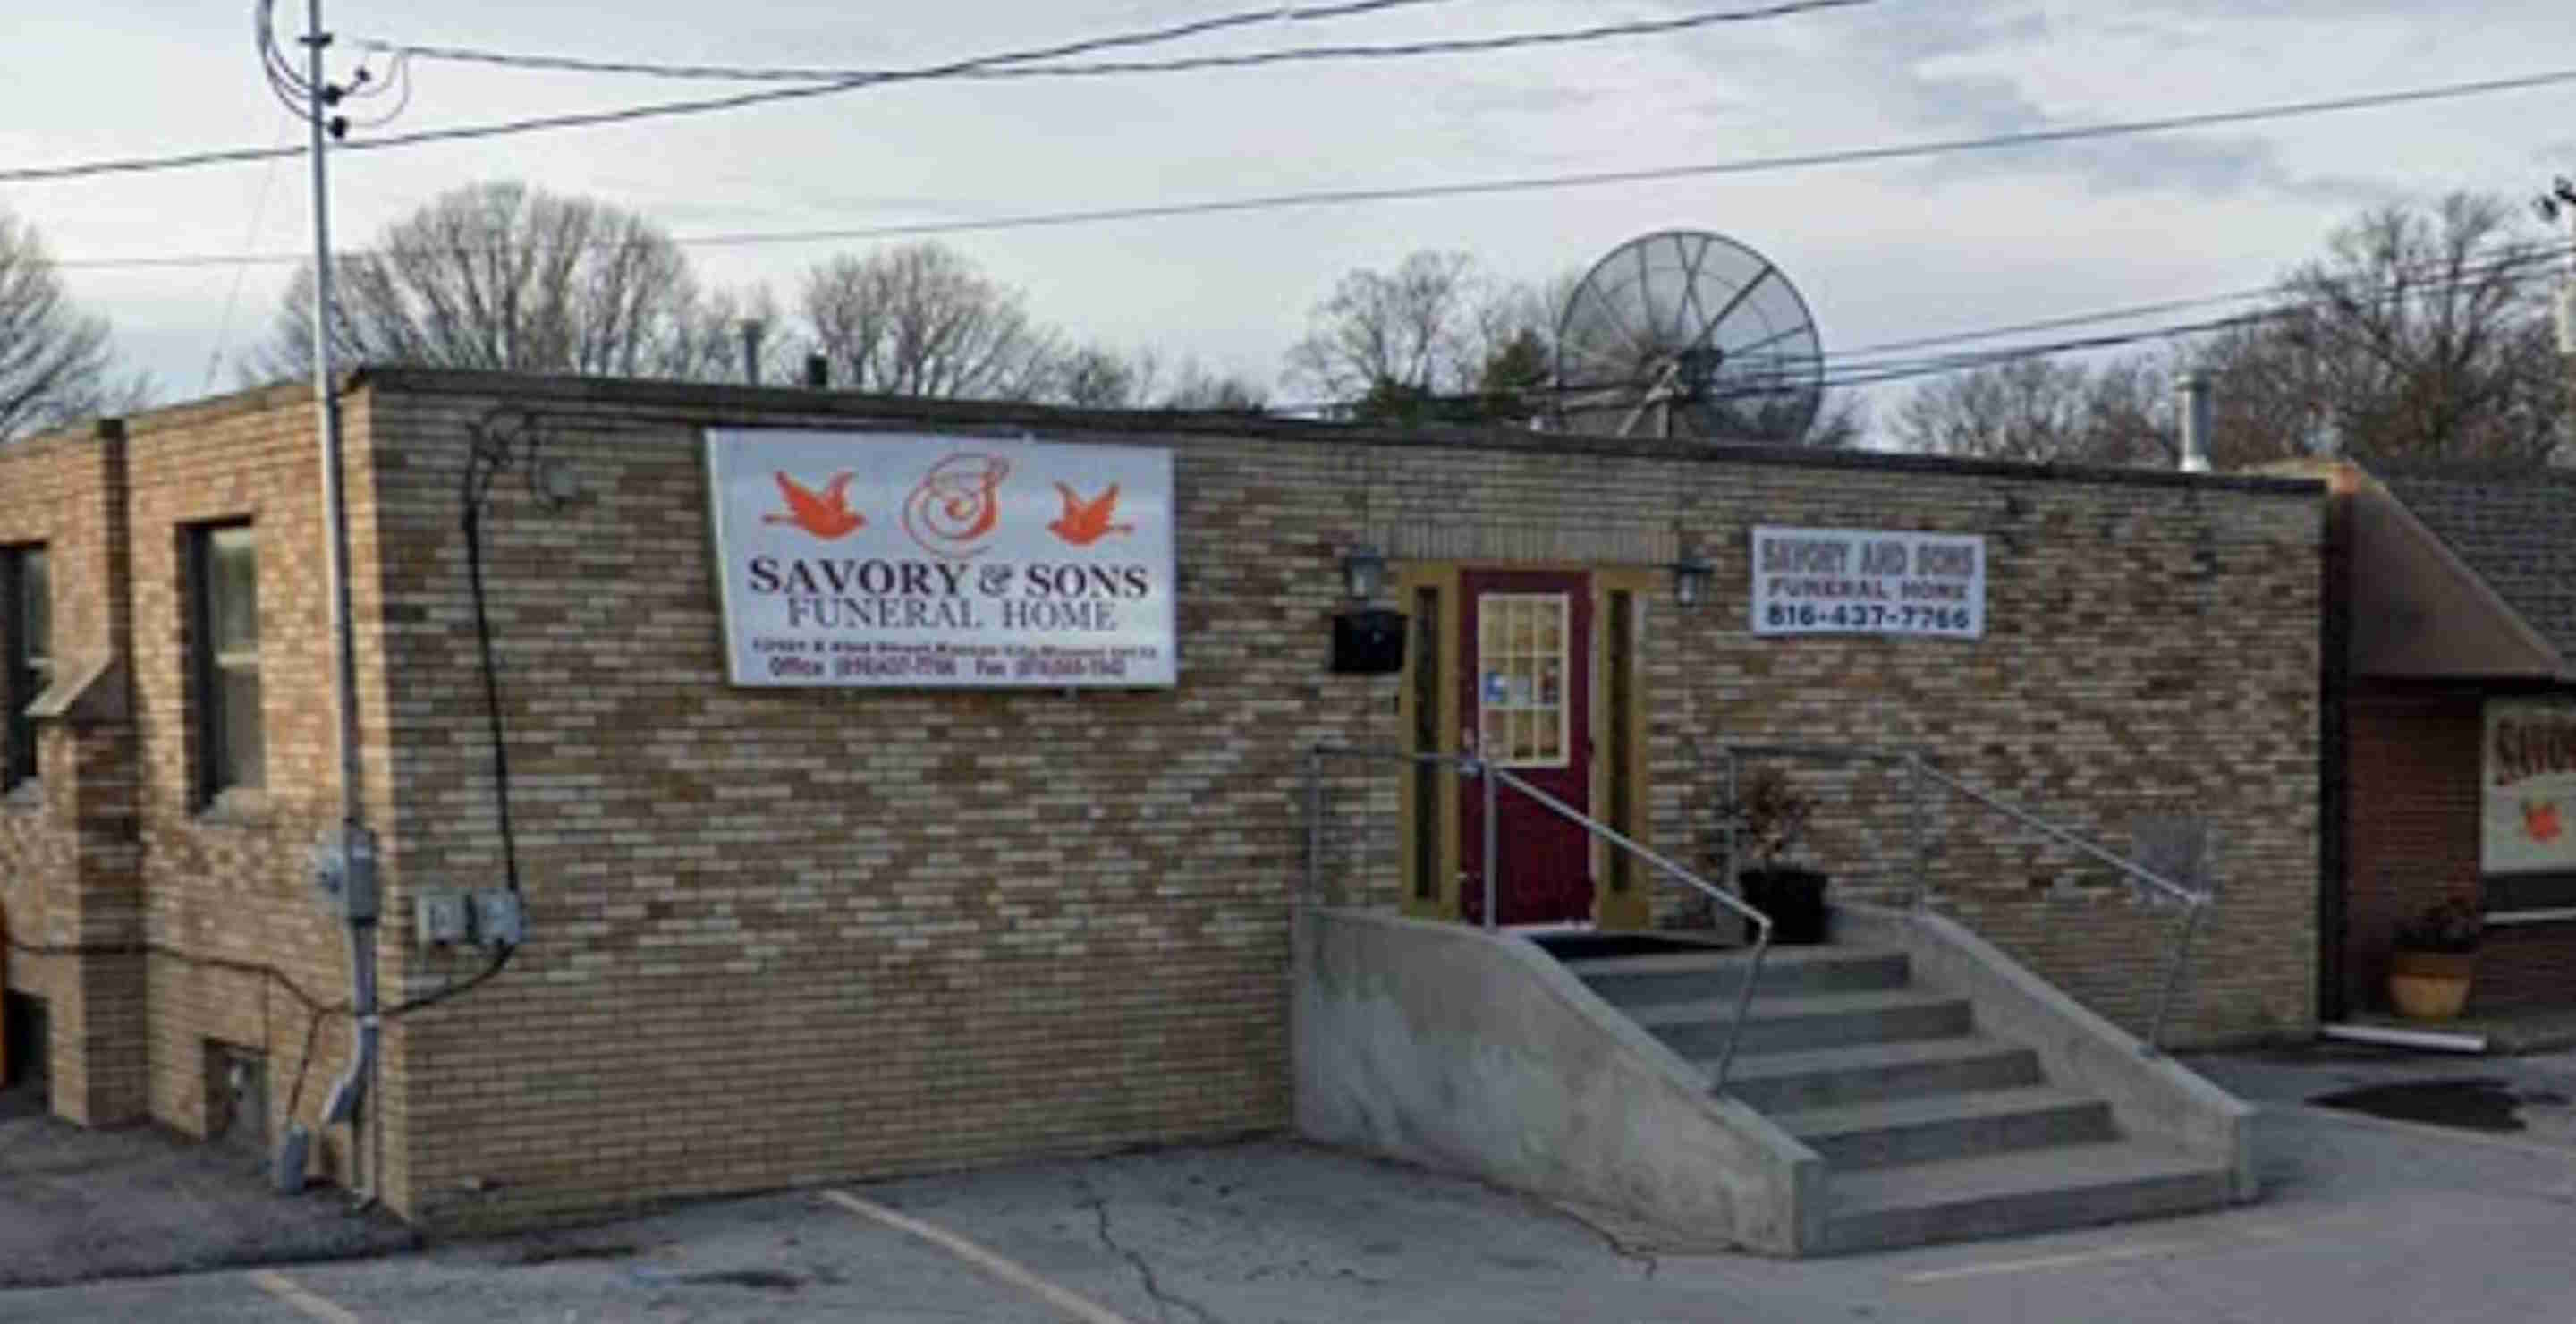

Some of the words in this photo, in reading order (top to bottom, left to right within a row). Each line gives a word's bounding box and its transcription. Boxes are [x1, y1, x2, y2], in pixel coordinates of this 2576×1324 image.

[750, 556, 969, 596] SAVORY
[979, 563, 1013, 598] &
[1026, 563, 1148, 599] SONS
[1767, 578, 1890, 600] FUNERAL
[1900, 581, 1968, 600] HOME
[787, 597, 983, 628] FUNERAL
[1003, 600, 1117, 630] HOME
